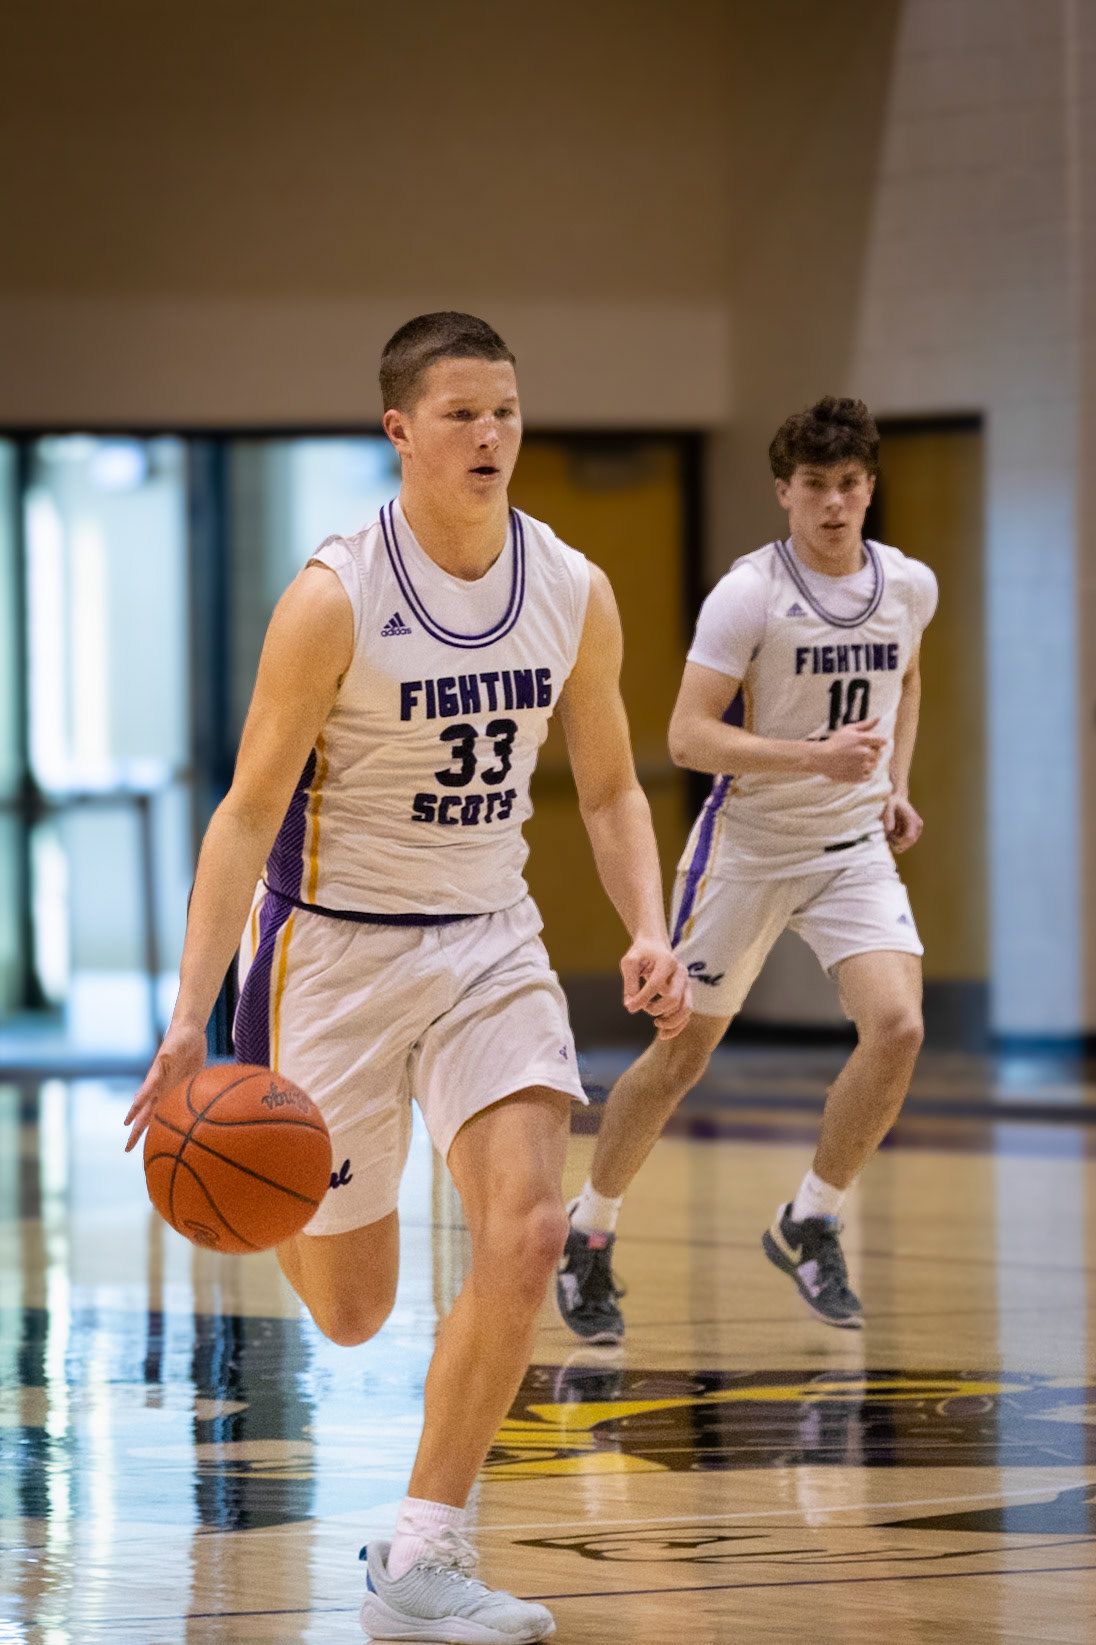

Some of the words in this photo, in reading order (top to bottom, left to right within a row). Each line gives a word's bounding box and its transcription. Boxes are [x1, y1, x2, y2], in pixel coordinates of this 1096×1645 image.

[381, 627, 412, 637] adidas
[795, 643, 899, 675] FIGHTING
[400, 668, 552, 721] FIGHTING
[829, 678, 870, 731] 10
[434, 719, 518, 787] 33
[411, 788, 517, 826] SCOTS
